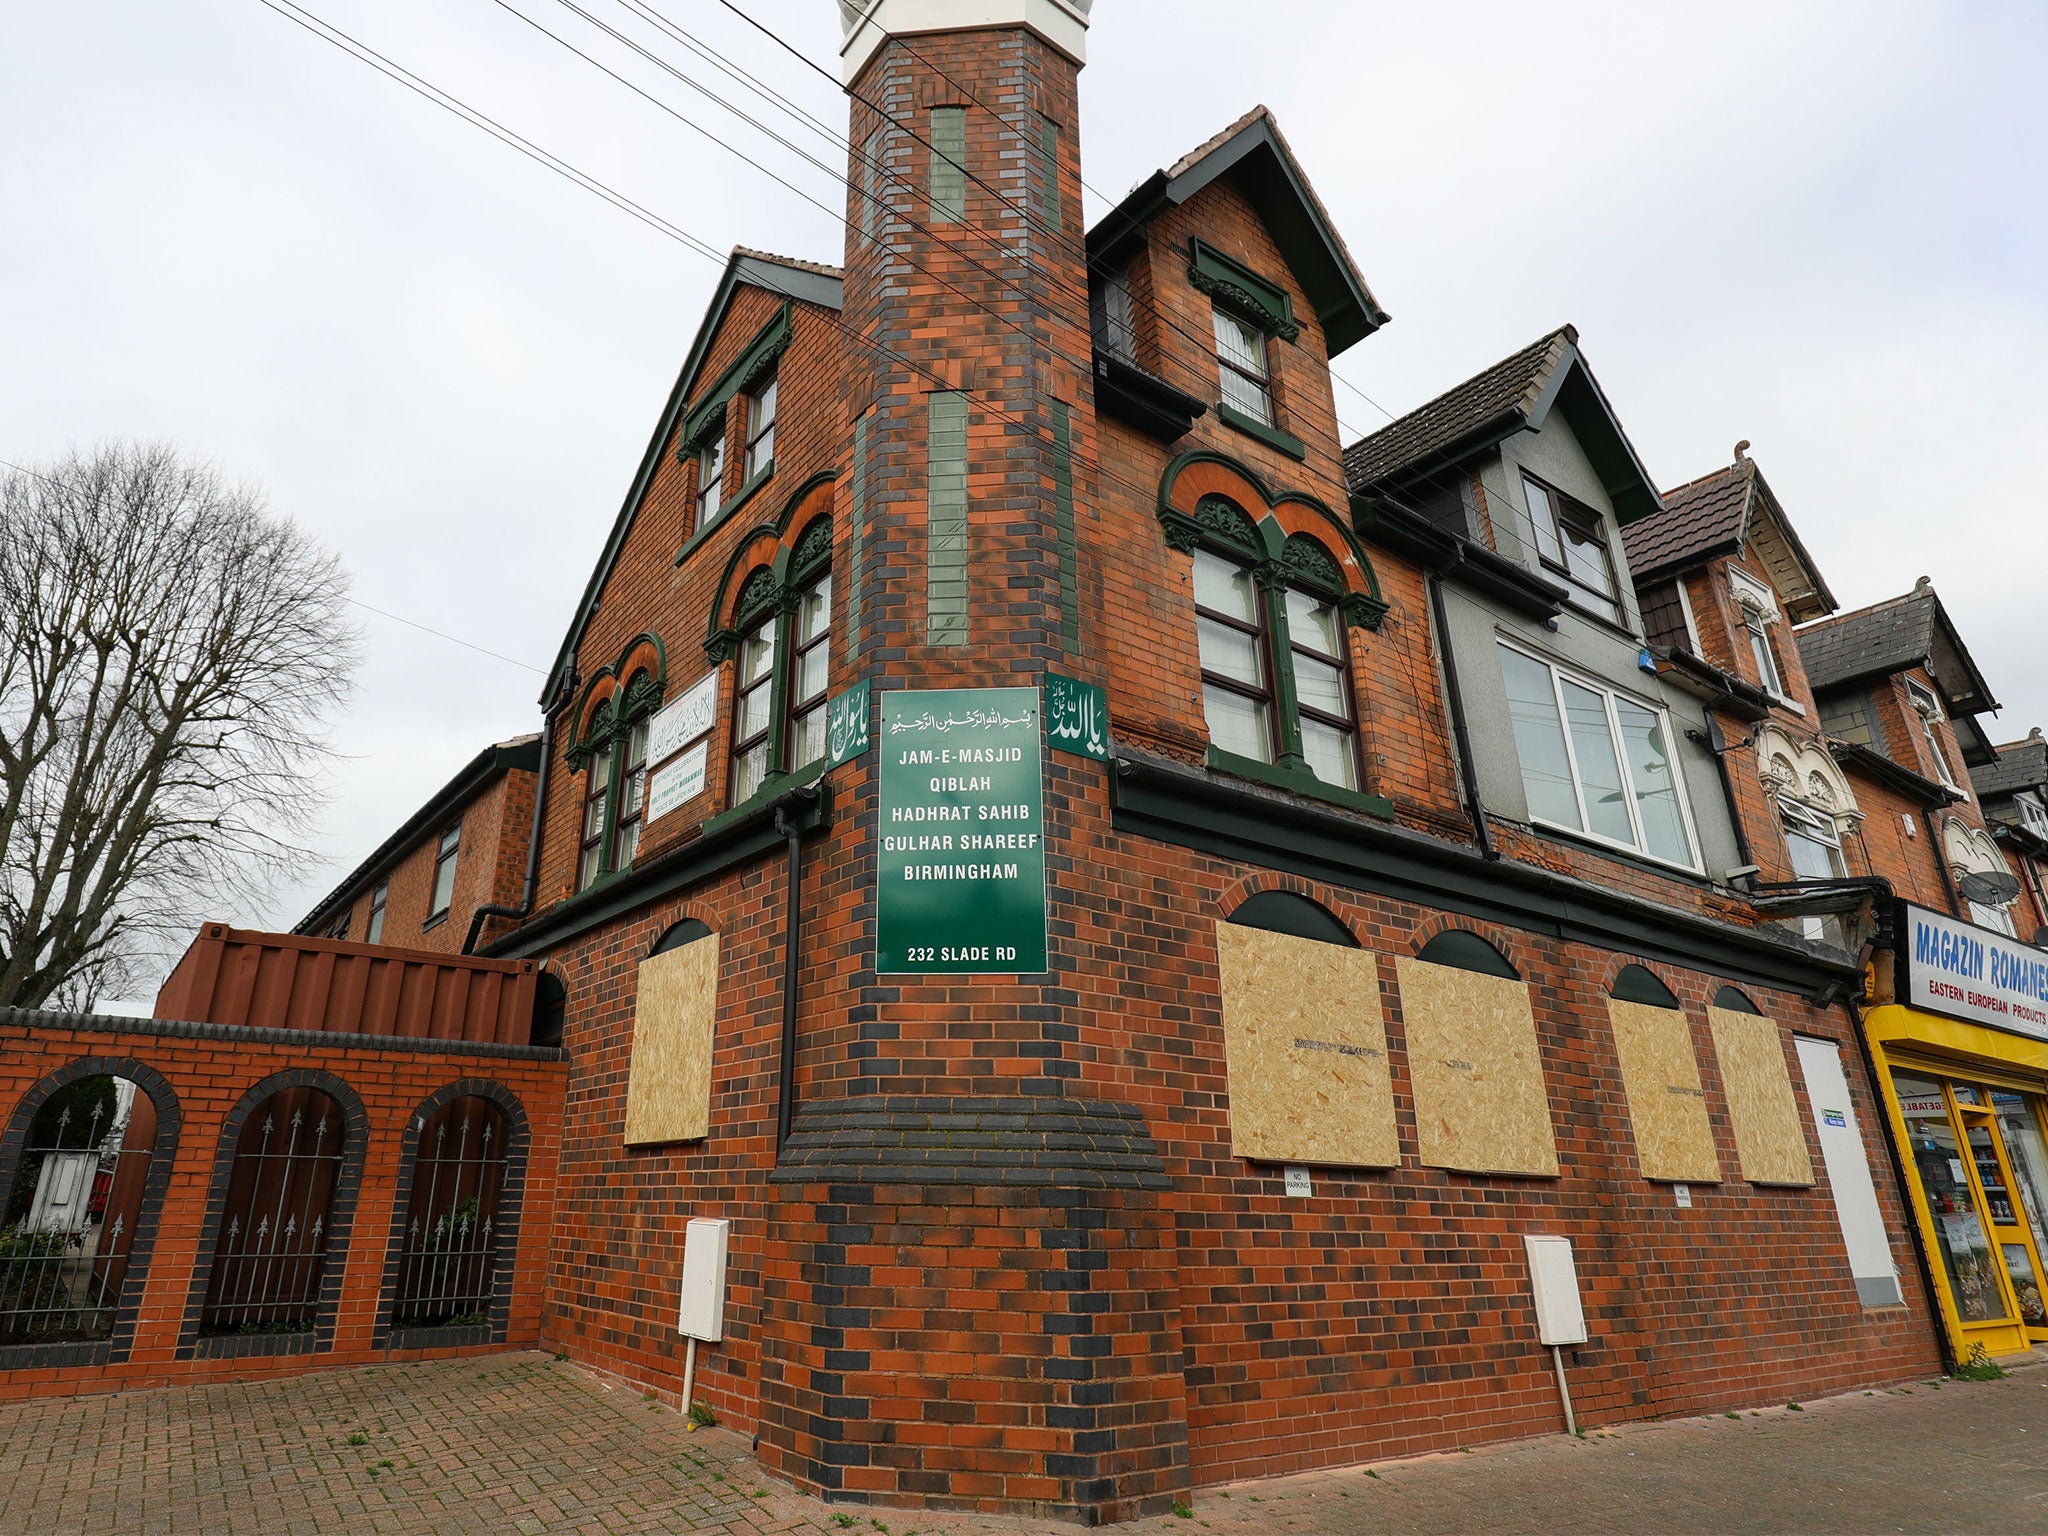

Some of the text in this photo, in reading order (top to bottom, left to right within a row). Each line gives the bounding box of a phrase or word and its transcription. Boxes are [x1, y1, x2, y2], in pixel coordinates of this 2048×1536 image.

[899, 748, 1022, 765] JAM-E-MASJID
[930, 777, 991, 793] QIBLAH
[892, 805, 1030, 822] HADHRAT SAHIB
[884, 834, 1038, 851] GULHAR SHAREEF
[904, 864, 1018, 880] BIRMINGHAM
[907, 947, 1016, 961] 232 SLADE RD
[1916, 921, 1983, 981] MAGAZIN
[1929, 980, 1964, 1002] EASTERN
[2013, 1003, 2047, 1025] PRODUCTS
[1286, 1181, 1310, 1189] PARKING
[1293, 1173, 1302, 1181] NO
